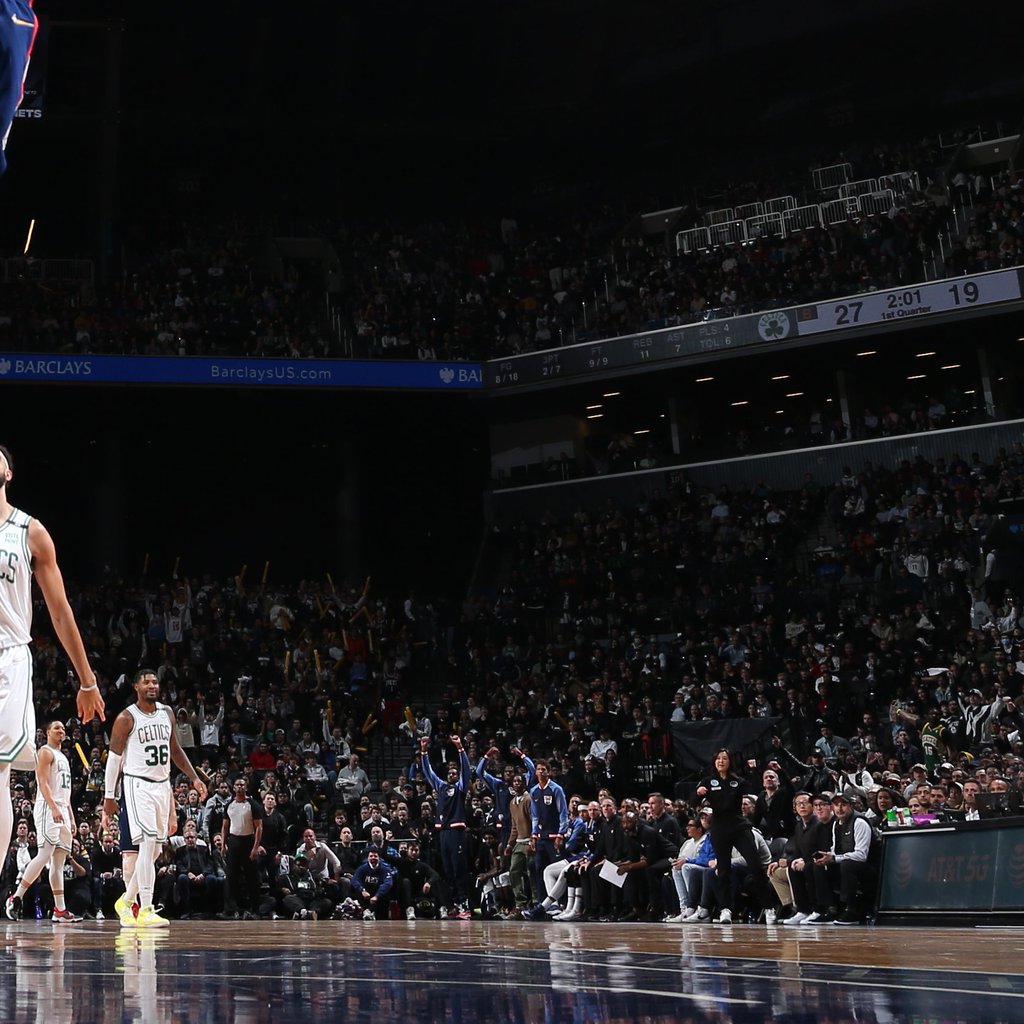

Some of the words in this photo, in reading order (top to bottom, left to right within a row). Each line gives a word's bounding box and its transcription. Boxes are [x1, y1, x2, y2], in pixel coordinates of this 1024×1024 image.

[15, 108, 42, 118] ETS
[886, 289, 922, 309] 2:01
[948, 281, 980, 306] 19
[834, 301, 864, 326] 27
[880, 310, 895, 321] 1st
[897, 305, 932, 319] Quarter
[14, 359, 93, 375] BARCLAYS
[210, 364, 332, 380] BarclaysUS.com
[137, 723, 170, 744] CELTICS
[144, 744, 169, 767] 36
